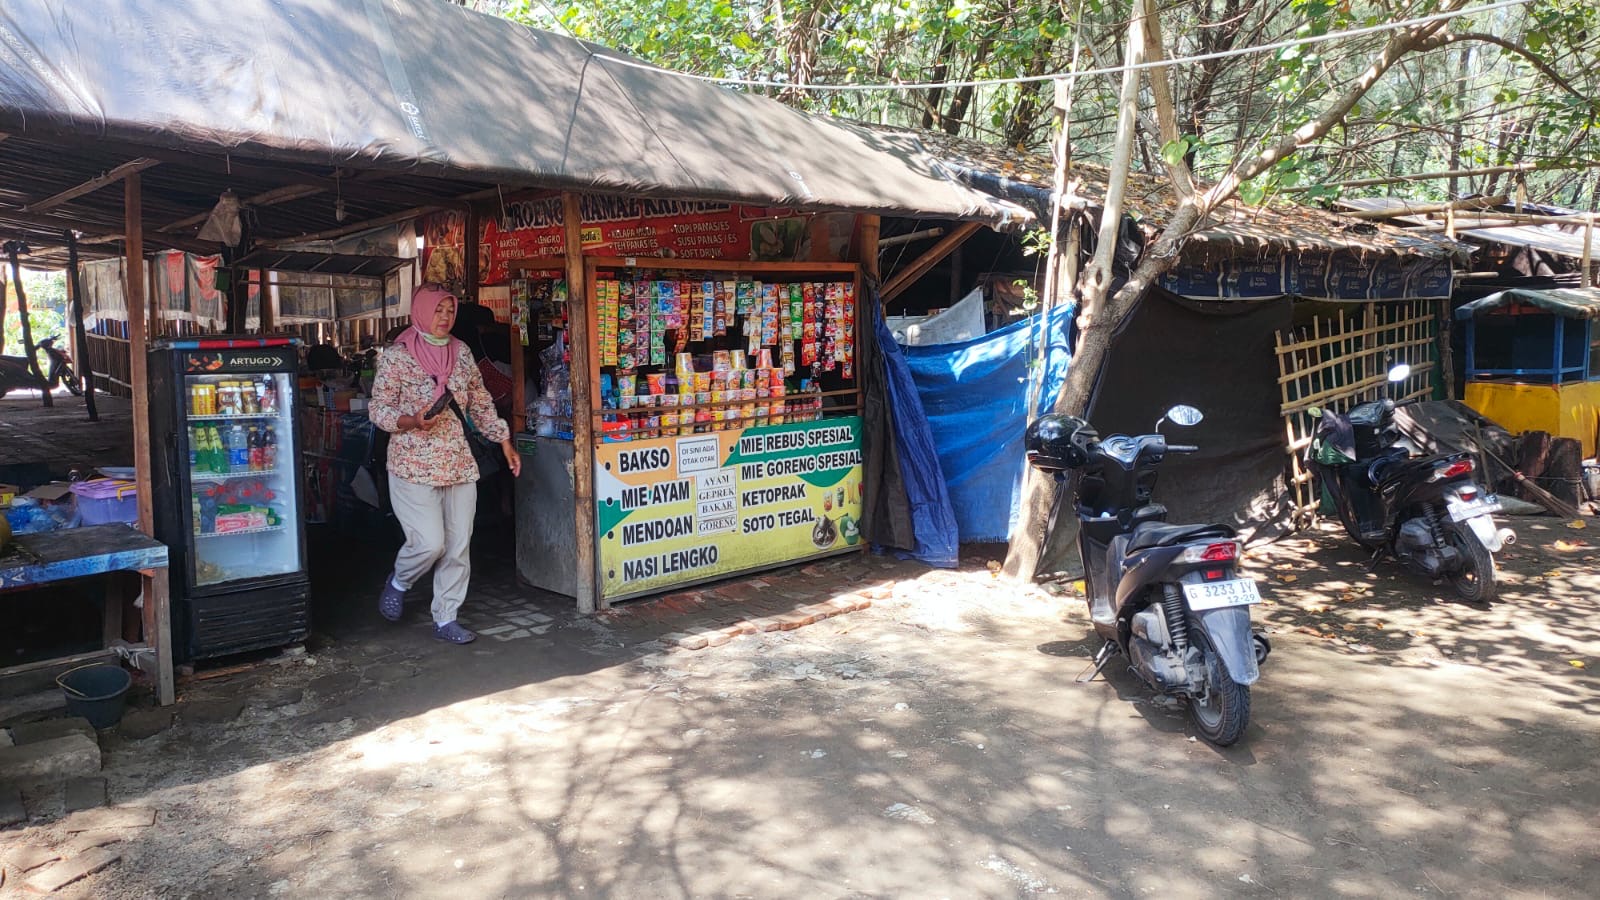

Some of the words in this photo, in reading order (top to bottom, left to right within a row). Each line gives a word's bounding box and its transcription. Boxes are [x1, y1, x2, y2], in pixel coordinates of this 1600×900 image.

[675, 223, 692, 234] KOPI
[614, 242, 626, 251] TEH
[677, 236, 697, 247] SUSU
[698, 234, 723, 245] PANAS
[680, 249, 699, 258] SOFT
[230, 357, 271, 365] ARTUGO
[741, 437, 763, 454] MIE
[766, 432, 805, 450] REBUS
[808, 426, 853, 446] SPESIAL
[619, 448, 670, 472] BAKSO
[699, 455, 715, 463] OTAK
[741, 463, 763, 480] MIE
[766, 457, 815, 477] GORENG
[817, 450, 862, 470] SPESIAL
[703, 474, 729, 487] AYAM
[621, 486, 648, 509] MIE
[652, 480, 690, 505] AYAM
[698, 488, 735, 500] GEPREK
[742, 483, 806, 507] KETOPRAK
[702, 501, 733, 514] BAKAR
[699, 517, 736, 532] GORENG
[743, 513, 775, 533] SOTO
[778, 508, 815, 527] TEGAL
[623, 515, 693, 546] MENDOAN
[623, 556, 658, 581] NASI
[662, 545, 718, 573] LENGKO
[1189, 588, 1198, 599] G
[1203, 583, 1235, 597] 3233
